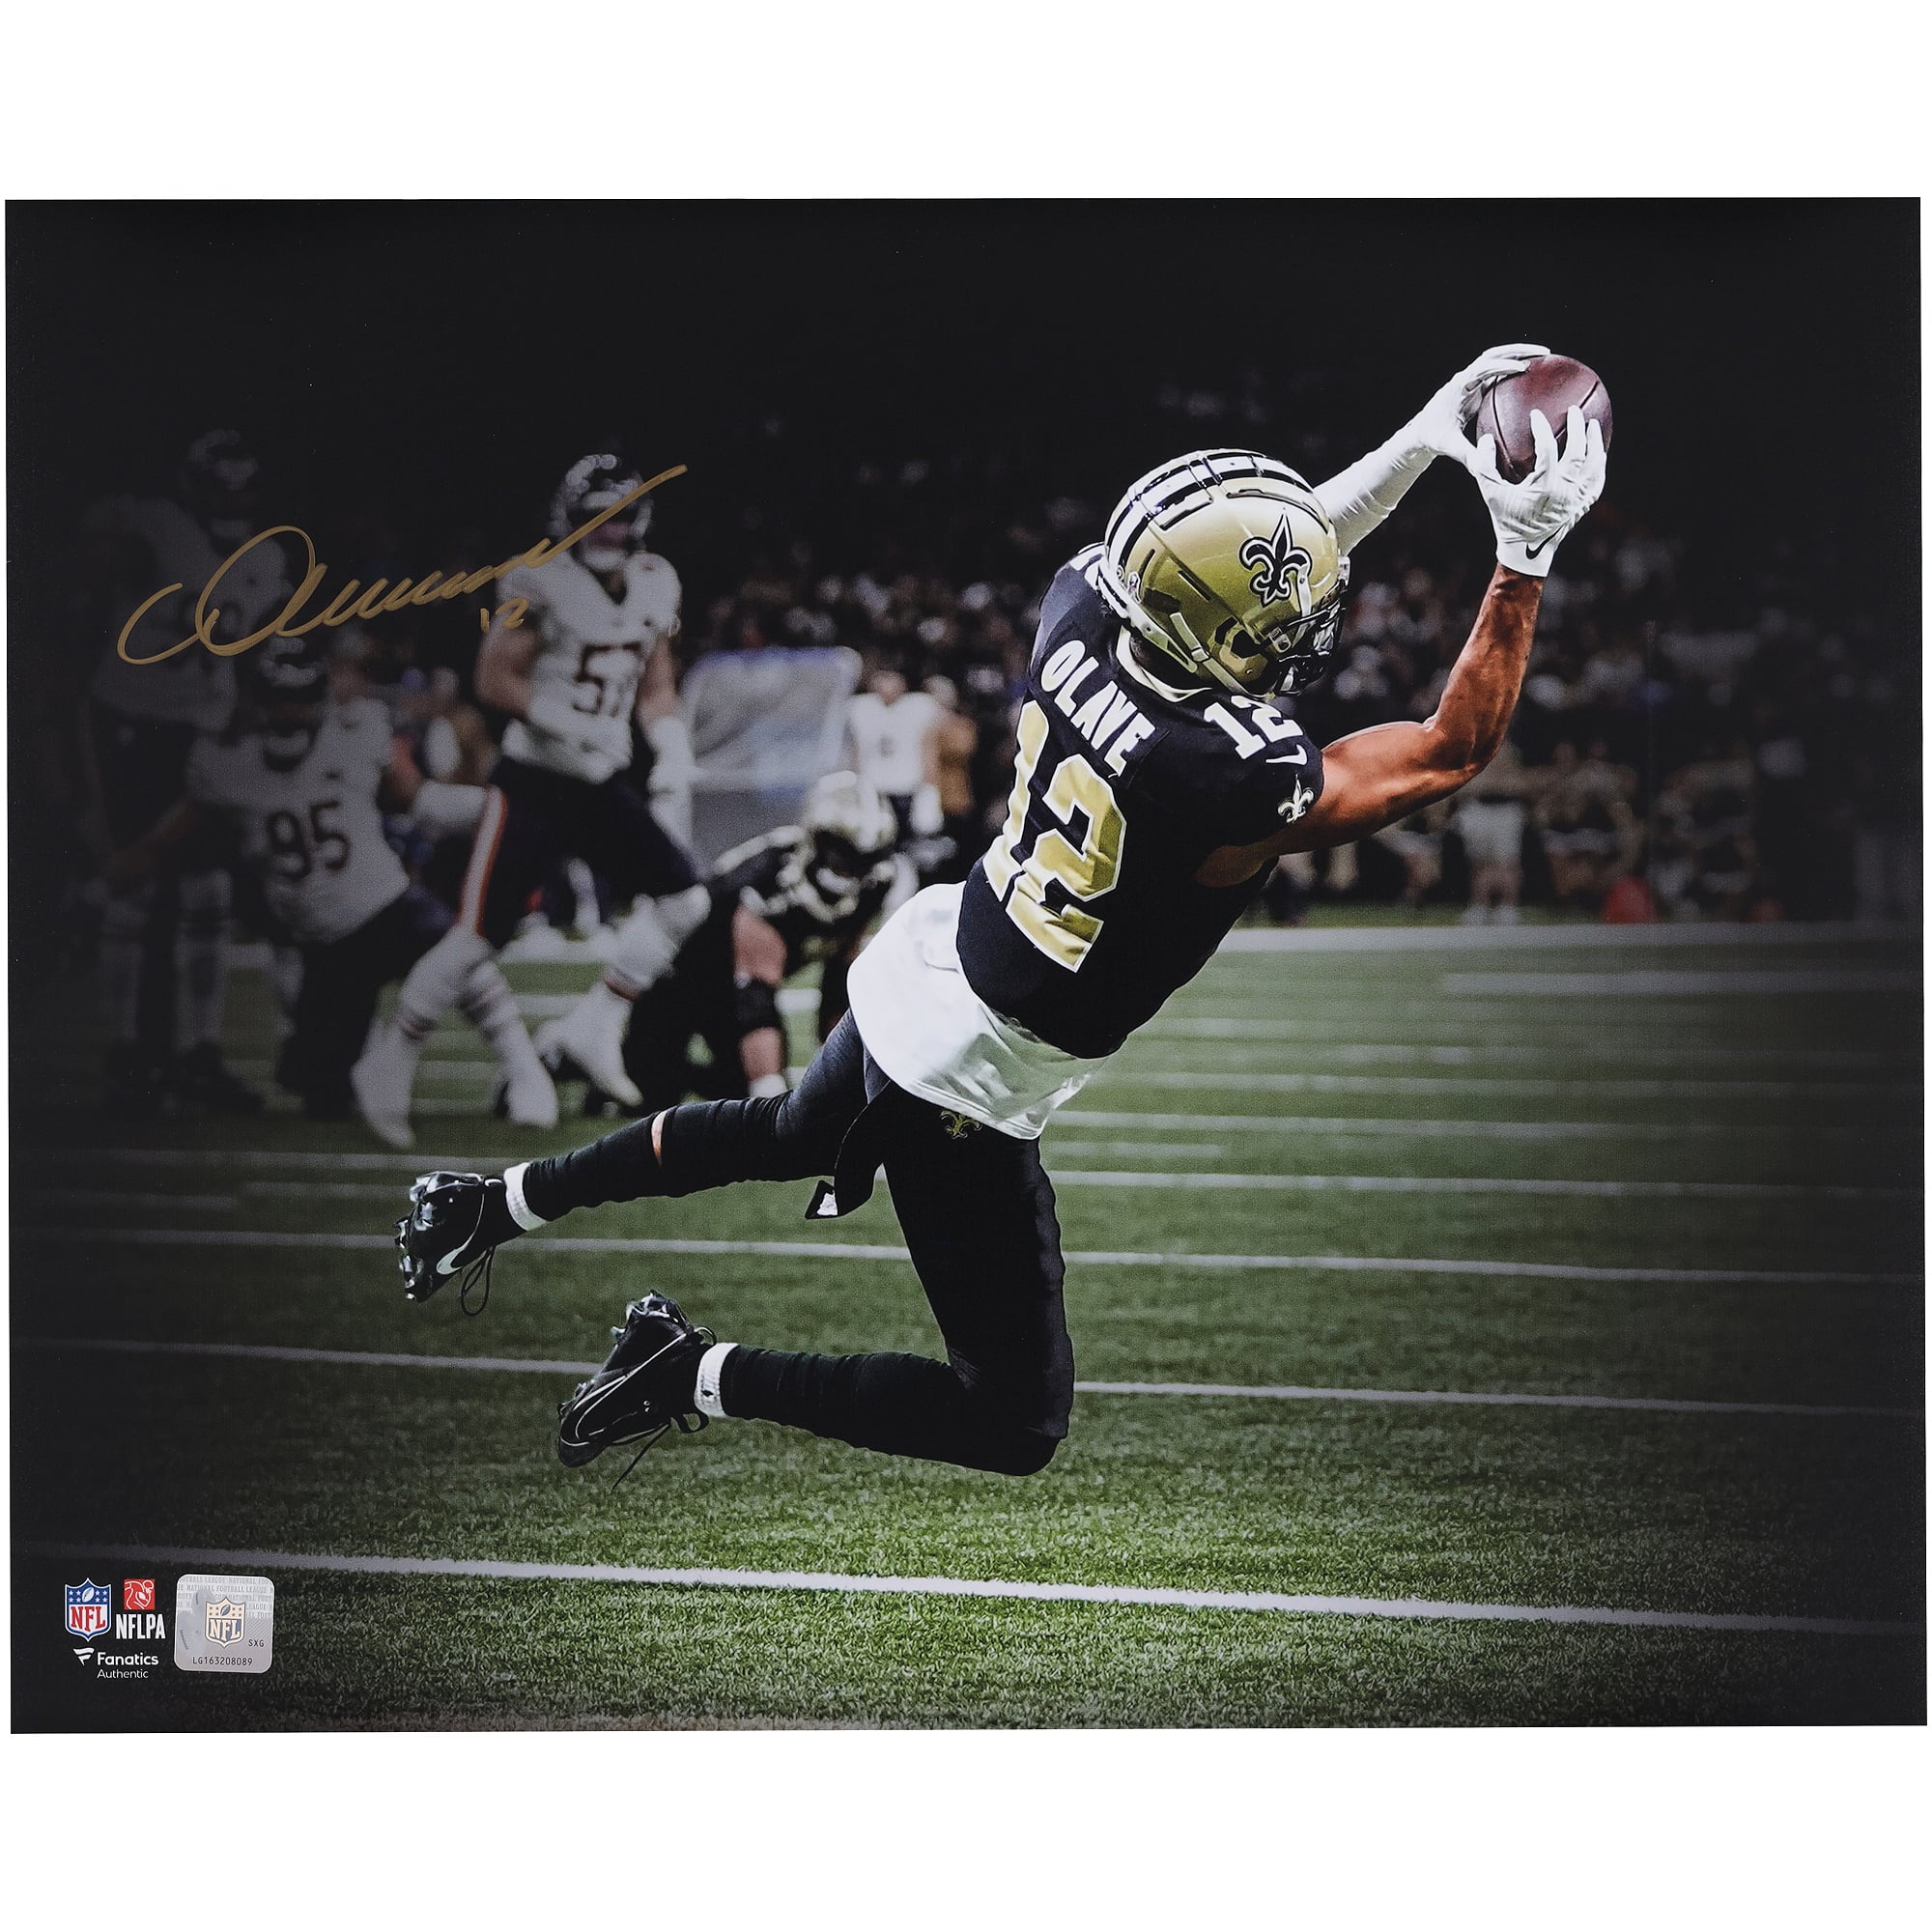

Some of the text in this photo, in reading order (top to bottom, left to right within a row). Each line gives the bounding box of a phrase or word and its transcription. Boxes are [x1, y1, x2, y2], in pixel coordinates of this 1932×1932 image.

[480, 597, 529, 634] 12
[1040, 639, 1156, 777] OLAVE
[1204, 695, 1303, 759] 12
[270, 801, 350, 882] 95
[982, 698, 1127, 973] 12
[70, 1605, 106, 1632] NFL
[115, 1613, 166, 1640] NFLPA
[209, 1618, 242, 1641] NFL
[247, 1638, 265, 1648] SXG
[98, 1651, 159, 1666] Fanatics
[192, 1656, 253, 1667] LG163208089
[97, 1668, 149, 1680] Authentic
